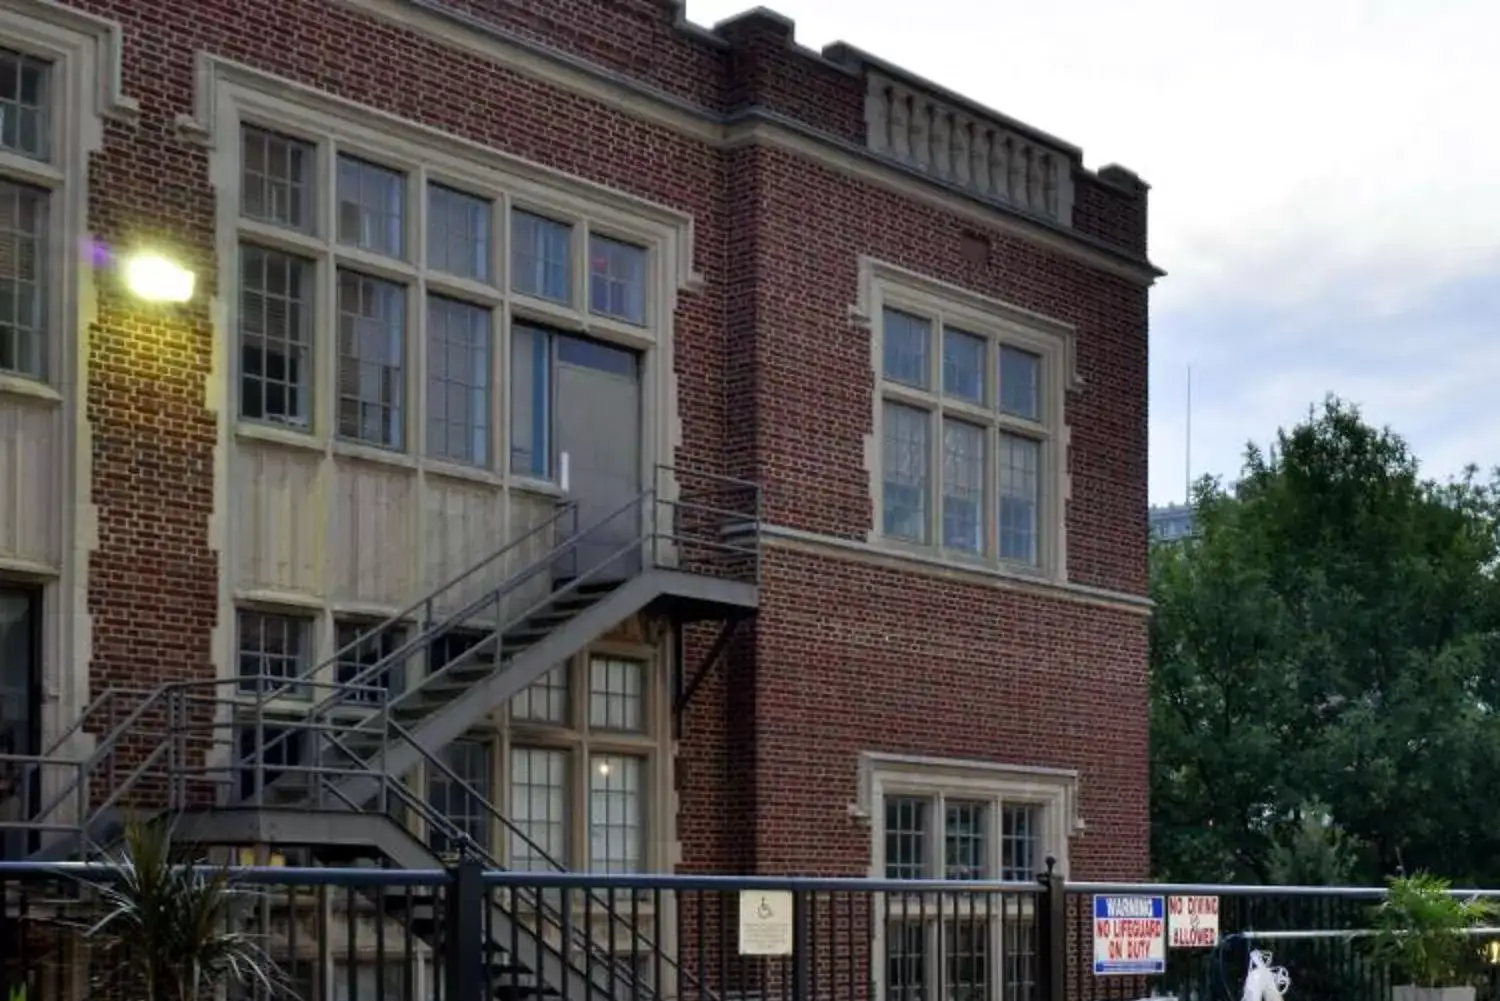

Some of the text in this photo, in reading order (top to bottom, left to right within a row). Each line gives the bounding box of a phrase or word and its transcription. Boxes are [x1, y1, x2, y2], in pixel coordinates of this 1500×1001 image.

[1106, 896, 1154, 917] WARNING
[1170, 897, 1217, 915] NO DIVING
[1097, 919, 1161, 938] NO LIFEGUARD
[1173, 928, 1214, 945] ALLOWED
[1108, 940, 1150, 959] ON DUTY
